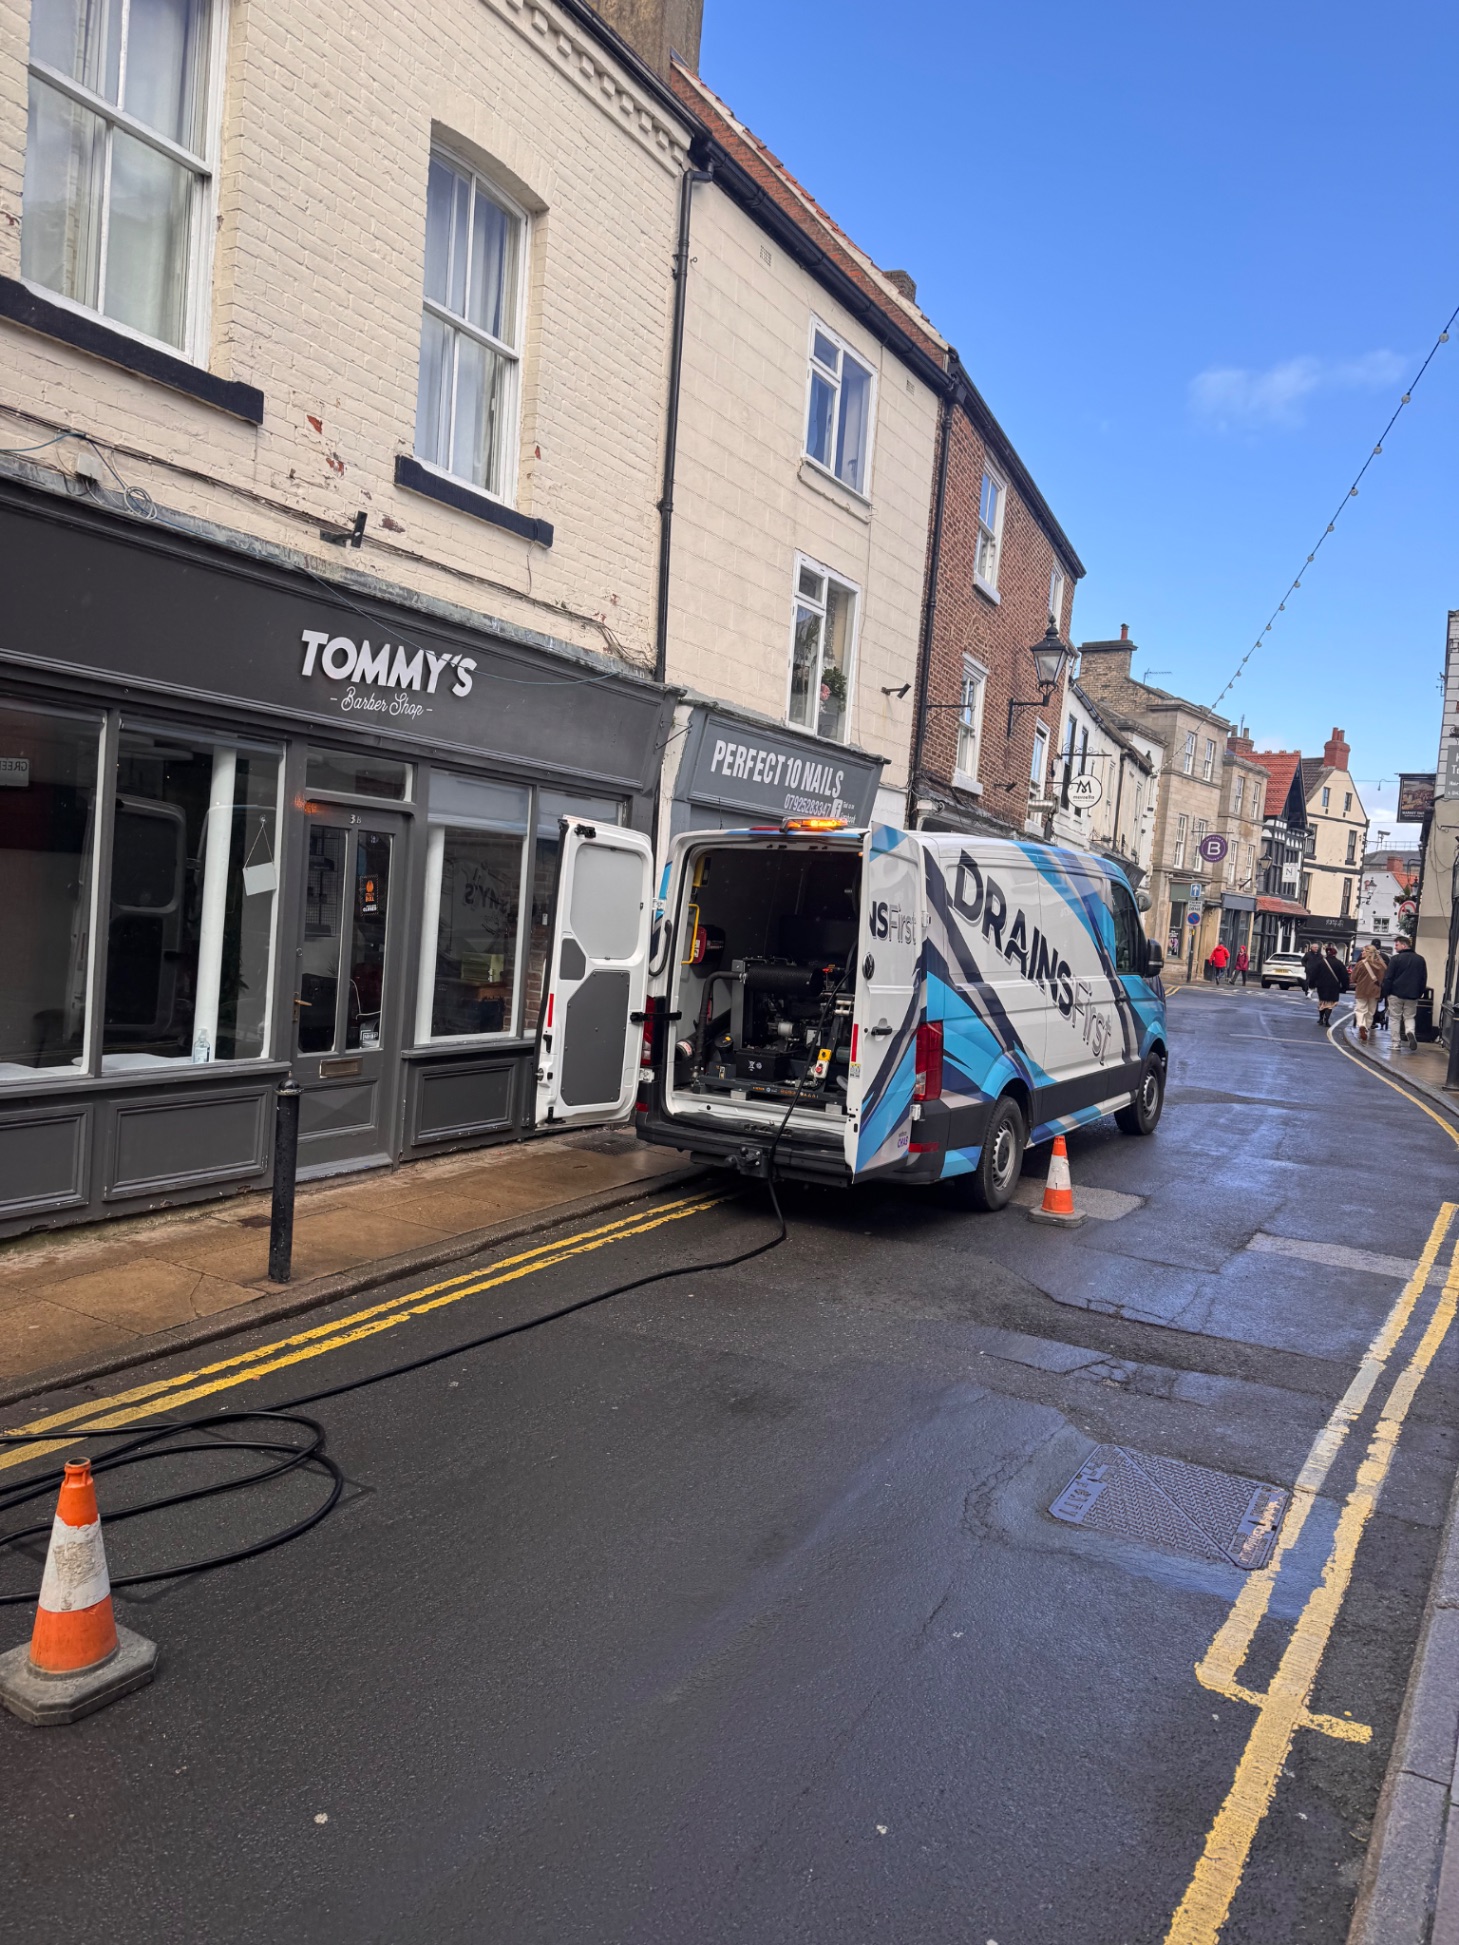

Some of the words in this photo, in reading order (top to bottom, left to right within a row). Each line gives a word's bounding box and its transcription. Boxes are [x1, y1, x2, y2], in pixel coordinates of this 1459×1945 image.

[301, 629, 478, 698] TOMMY'S
[340, 686, 389, 711] Barber
[388, 692, 424, 720] Shop
[710, 739, 786, 786] PERFECT
[784, 757, 802, 789] 10
[800, 761, 845, 798] NAILS
[1206, 841, 1221, 855] B
[888, 903, 916, 945] First
[952, 847, 1074, 1020] DRAINS
[1071, 973, 1112, 1067] First
